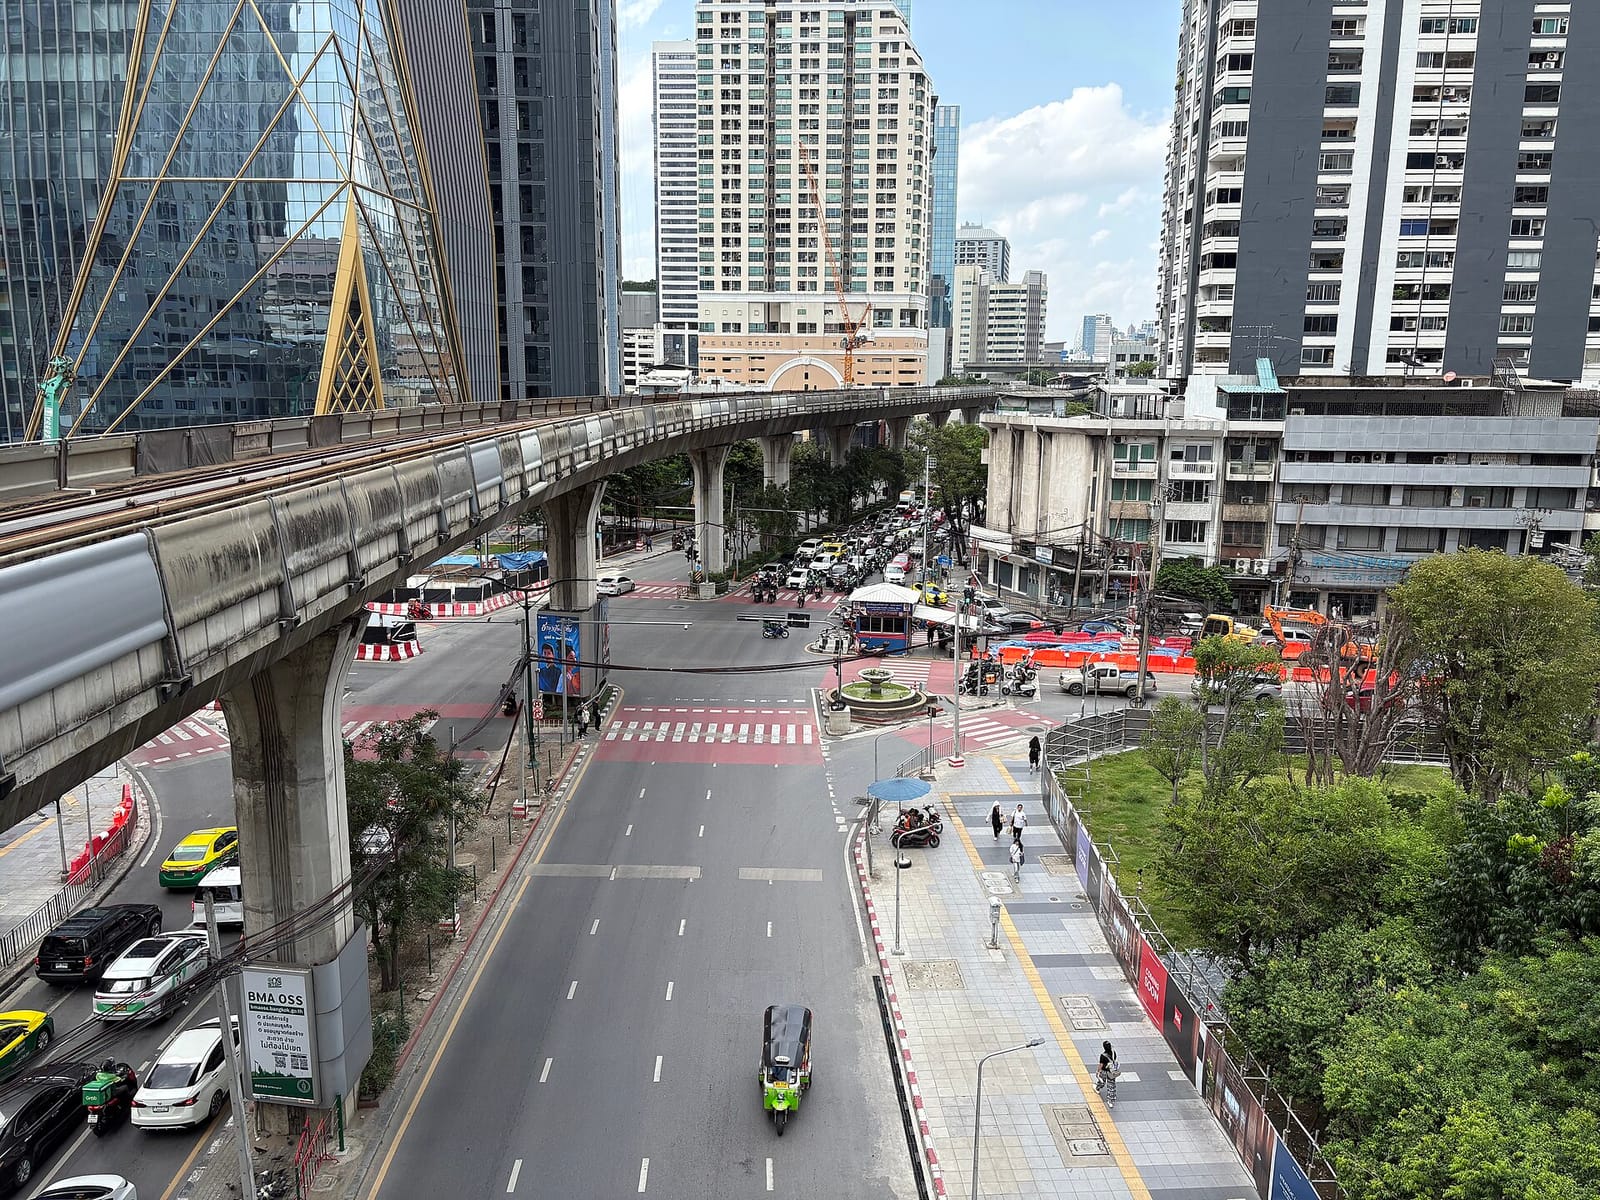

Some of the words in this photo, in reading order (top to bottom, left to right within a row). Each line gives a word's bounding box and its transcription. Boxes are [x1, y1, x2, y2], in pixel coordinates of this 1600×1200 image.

[1144, 976, 1160, 1004] SOON
[1145, 967, 1160, 991] COMING
[248, 991, 275, 1003] BMA
[278, 993, 303, 1006] OSS
